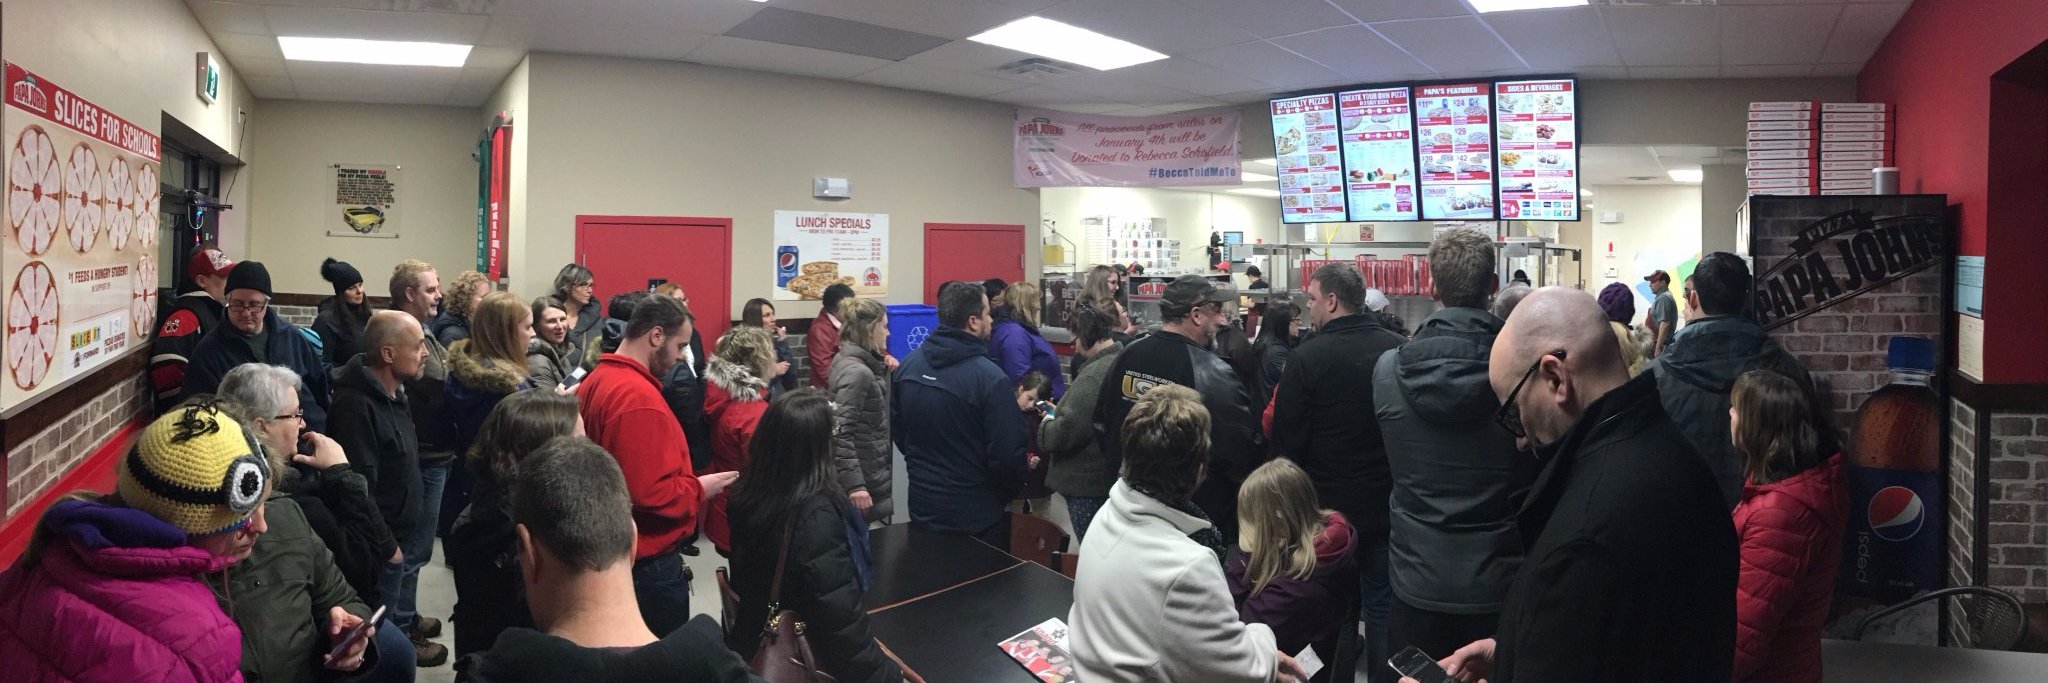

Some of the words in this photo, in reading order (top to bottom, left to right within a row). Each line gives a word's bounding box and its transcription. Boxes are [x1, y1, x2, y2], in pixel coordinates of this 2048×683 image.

[1276, 99, 1307, 110] SPECIALTY
[1308, 97, 1329, 106] PIZZAS
[1342, 94, 1361, 102] CREATE
[54, 90, 98, 135] SLICES
[101, 112, 120, 144] FOR
[122, 123, 156, 158] SCHOOLS
[1019, 122, 1038, 136] PAPA
[1078, 123, 1095, 132] All
[1096, 124, 1144, 134] proceeds
[1146, 121, 1174, 134] from
[1177, 117, 1204, 127] sales
[1095, 137, 1144, 152] January
[1148, 134, 1165, 145] 4th
[1169, 132, 1192, 142] will
[1193, 132, 1206, 142] be
[1071, 151, 1116, 162] Donated
[1120, 151, 1129, 161] to
[1134, 150, 1177, 161] Rebecca
[1148, 167, 1236, 178] #BeccaToldMeTo
[796, 216, 826, 228] LUNCH
[829, 218, 871, 230] SPECIALS
[1806, 213, 1858, 242] PIZZA
[75, 268, 90, 284] FEEDS
[95, 267, 110, 280] HUNGRY
[1139, 284, 1154, 294] PAPA
[1757, 250, 1842, 328] PAPA
[1126, 370, 1141, 378] UNITED
[1856, 531, 1871, 583] pepsi
